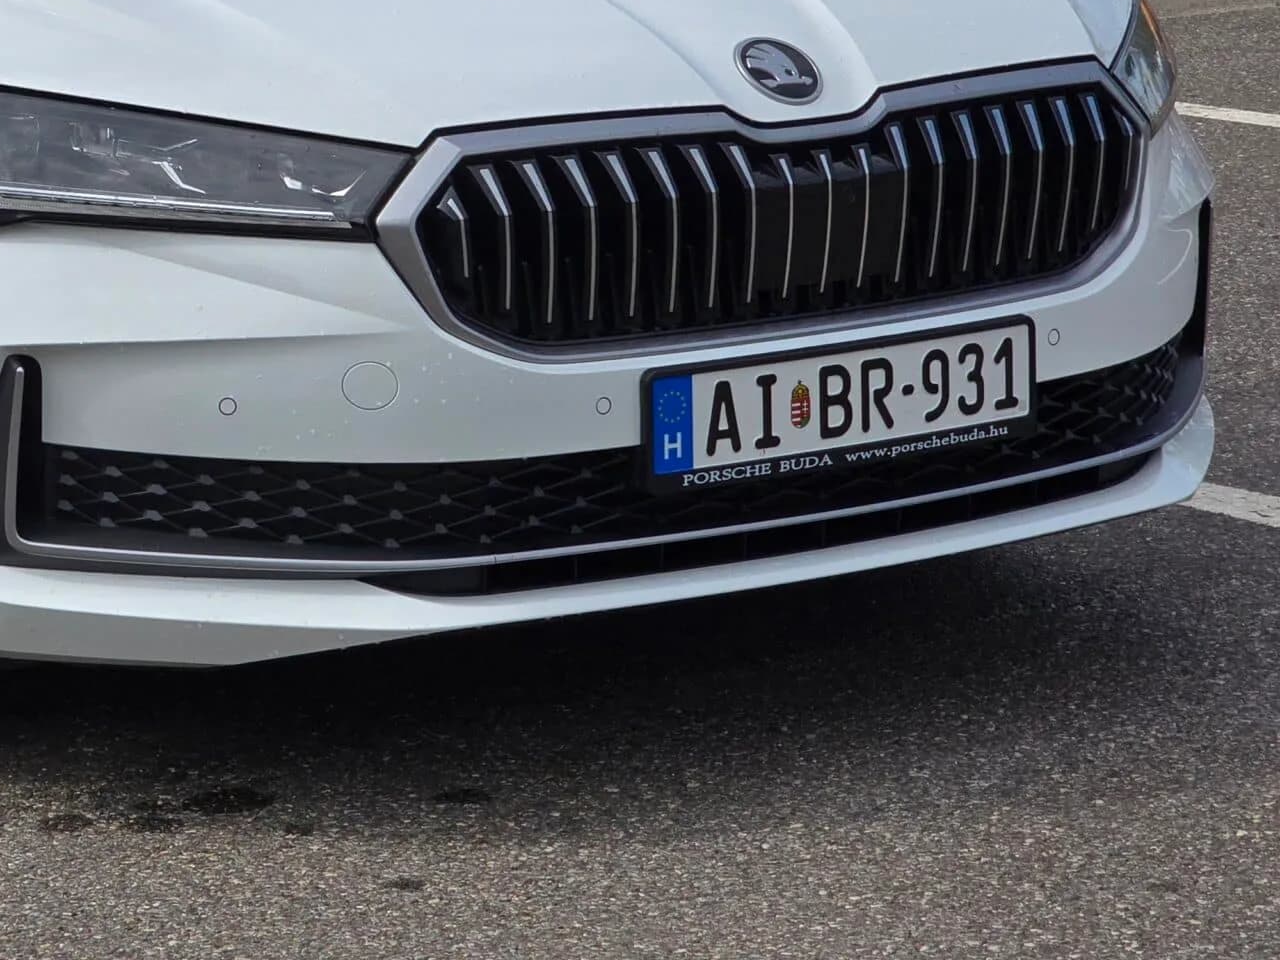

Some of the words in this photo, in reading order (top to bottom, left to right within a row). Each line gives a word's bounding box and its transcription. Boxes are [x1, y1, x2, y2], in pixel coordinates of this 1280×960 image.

[663, 432, 682, 460] H
[706, 373, 781, 457] AI
[682, 462, 772, 488] PORSCHE
[779, 453, 834, 474] BUDA
[845, 423, 1009, 463] www.porschebuda.hu
